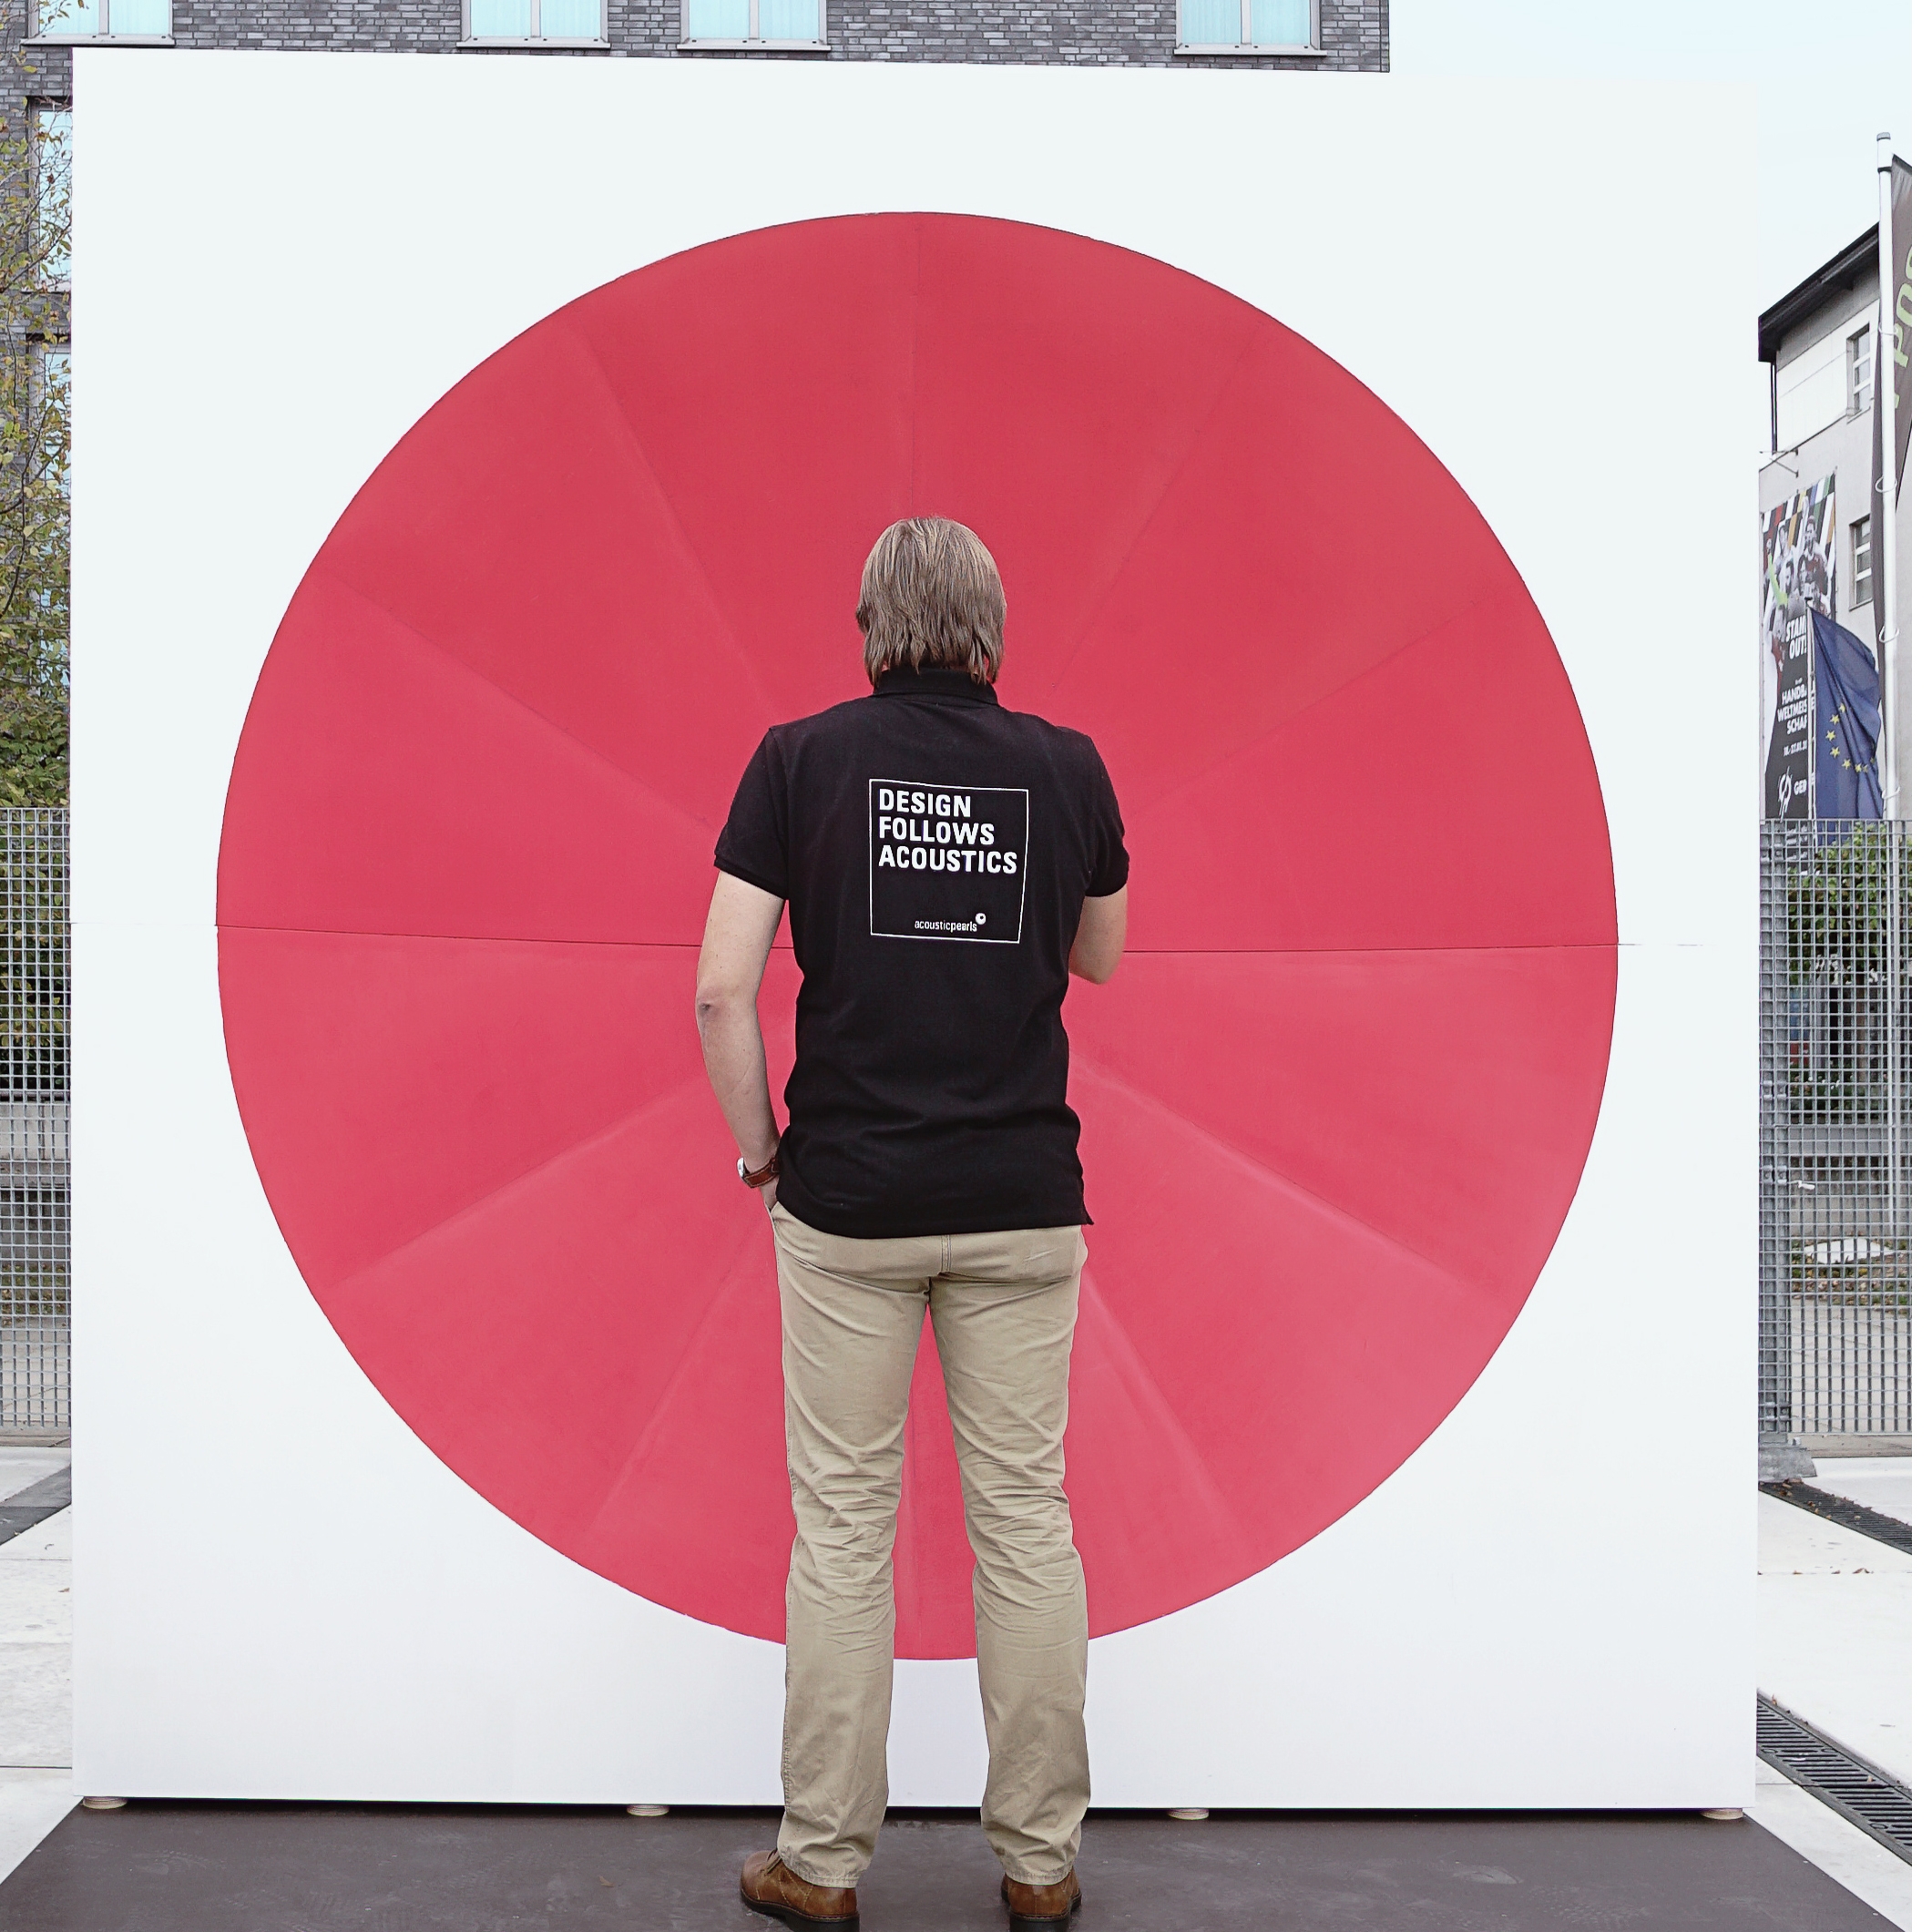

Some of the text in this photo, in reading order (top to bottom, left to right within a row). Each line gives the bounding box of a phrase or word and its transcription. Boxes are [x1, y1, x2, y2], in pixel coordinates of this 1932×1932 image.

[878, 788, 971, 817] DESIGN
[878, 816, 995, 845] FOLLOWS
[878, 844, 1017, 874] ACOUSTICS
[914, 920, 977, 934] acousticpearls
